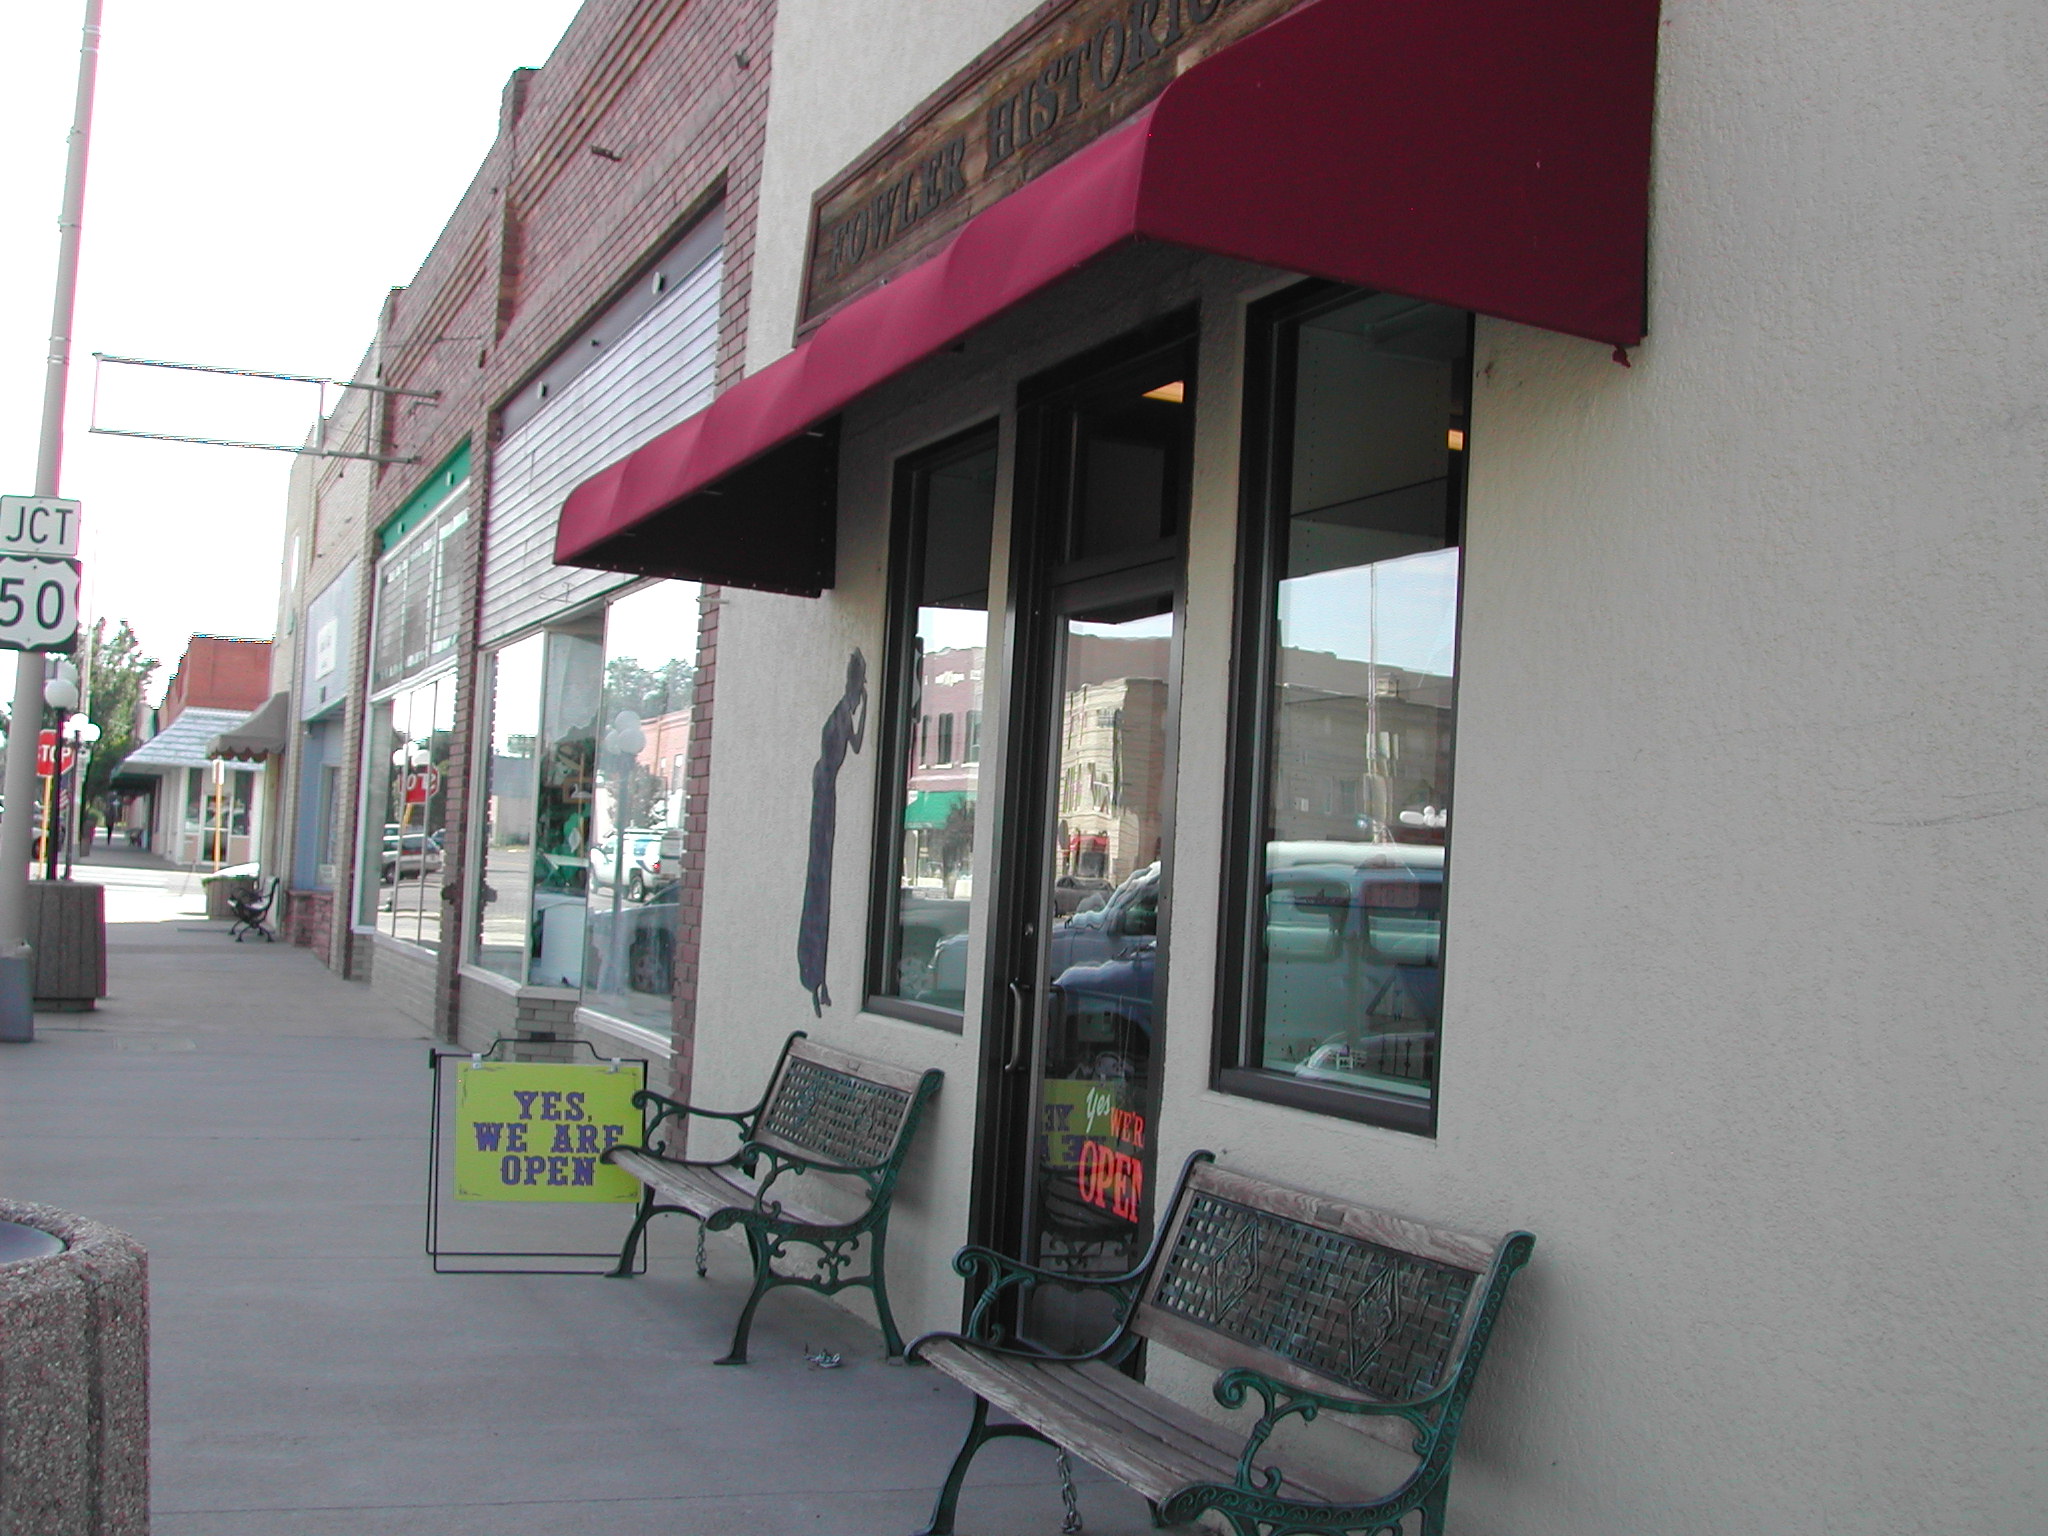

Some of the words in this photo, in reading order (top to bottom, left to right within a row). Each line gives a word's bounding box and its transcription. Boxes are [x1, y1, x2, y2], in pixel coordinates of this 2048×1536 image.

[829, 137, 966, 279] FOWLER
[5, 506, 74, 545] JCT
[0, 577, 65, 630] 50
[513, 1091, 592, 1123] YES,
[473, 1122, 527, 1152] WE
[551, 1124, 624, 1154] ARE
[501, 1155, 596, 1186] OPEN
[1079, 1140, 1144, 1223] OPEN
